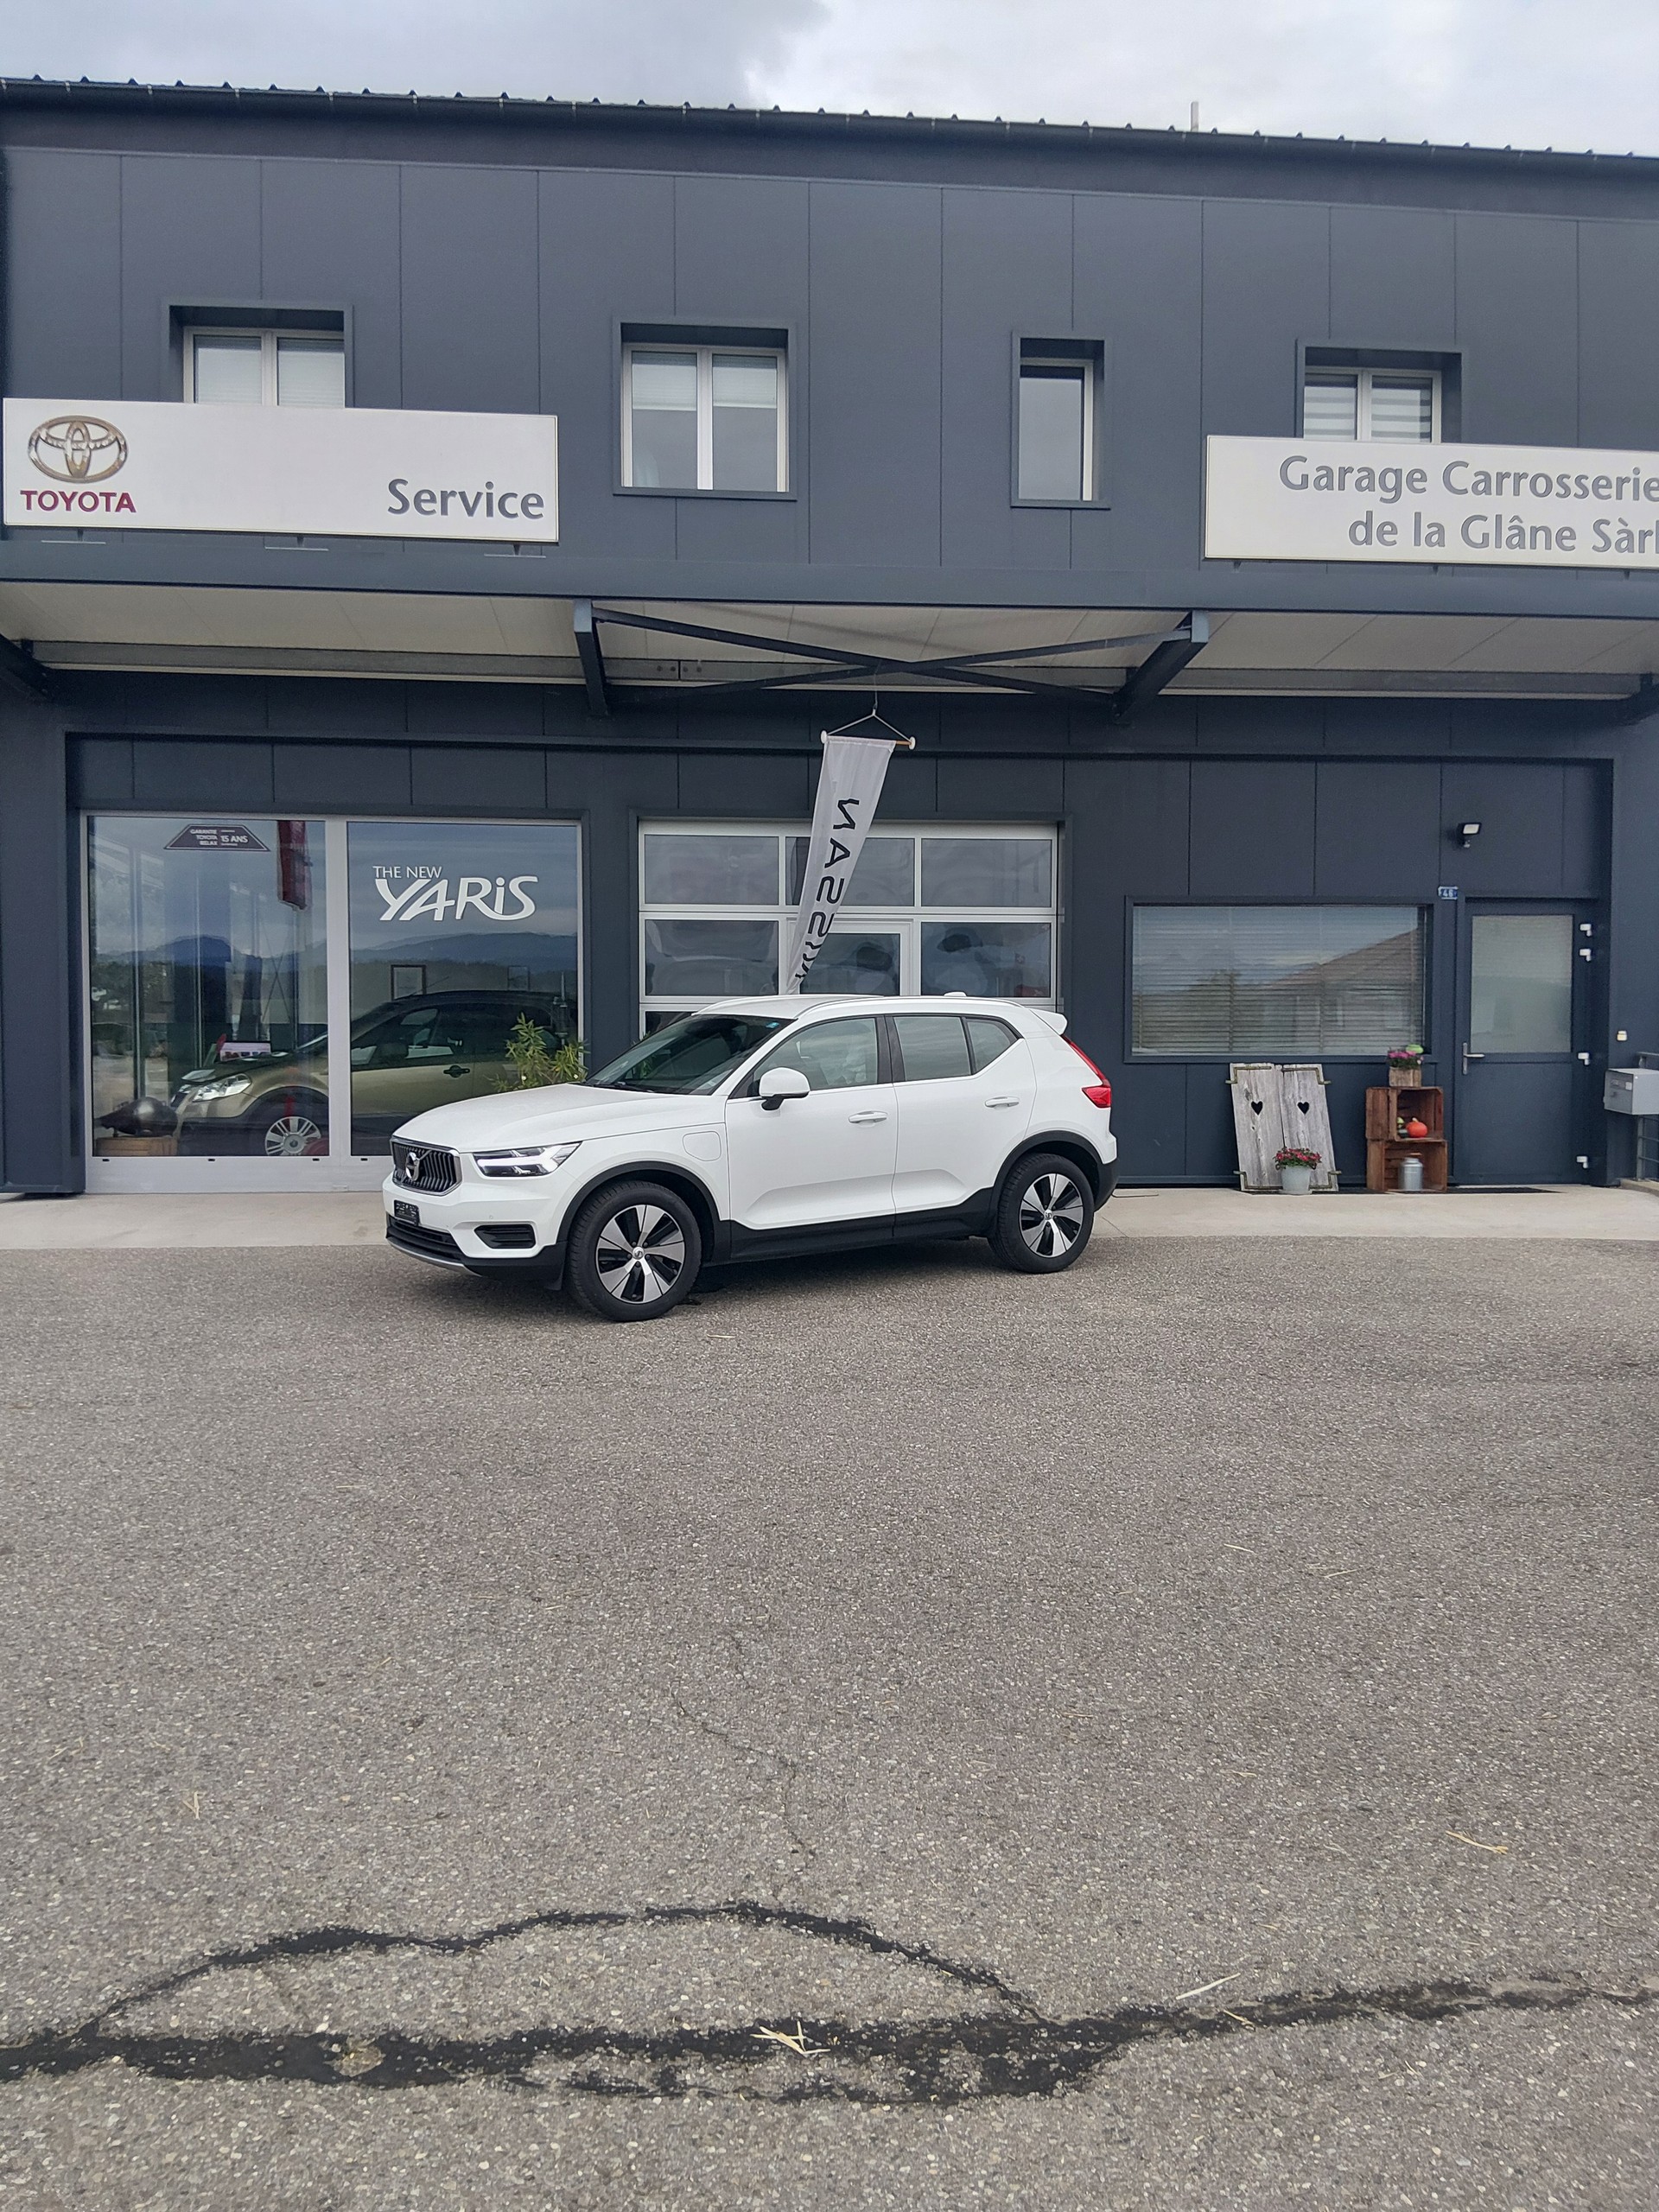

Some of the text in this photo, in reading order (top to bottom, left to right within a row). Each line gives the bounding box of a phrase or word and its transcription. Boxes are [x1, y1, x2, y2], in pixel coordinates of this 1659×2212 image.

[388, 479, 544, 519] Service
[1280, 455, 1659, 504] Garage Carrosserie
[20, 490, 137, 512] TOYOTA
[1349, 511, 1659, 554] de la Glâne Sàrl
[372, 866, 442, 879] THE NEW
